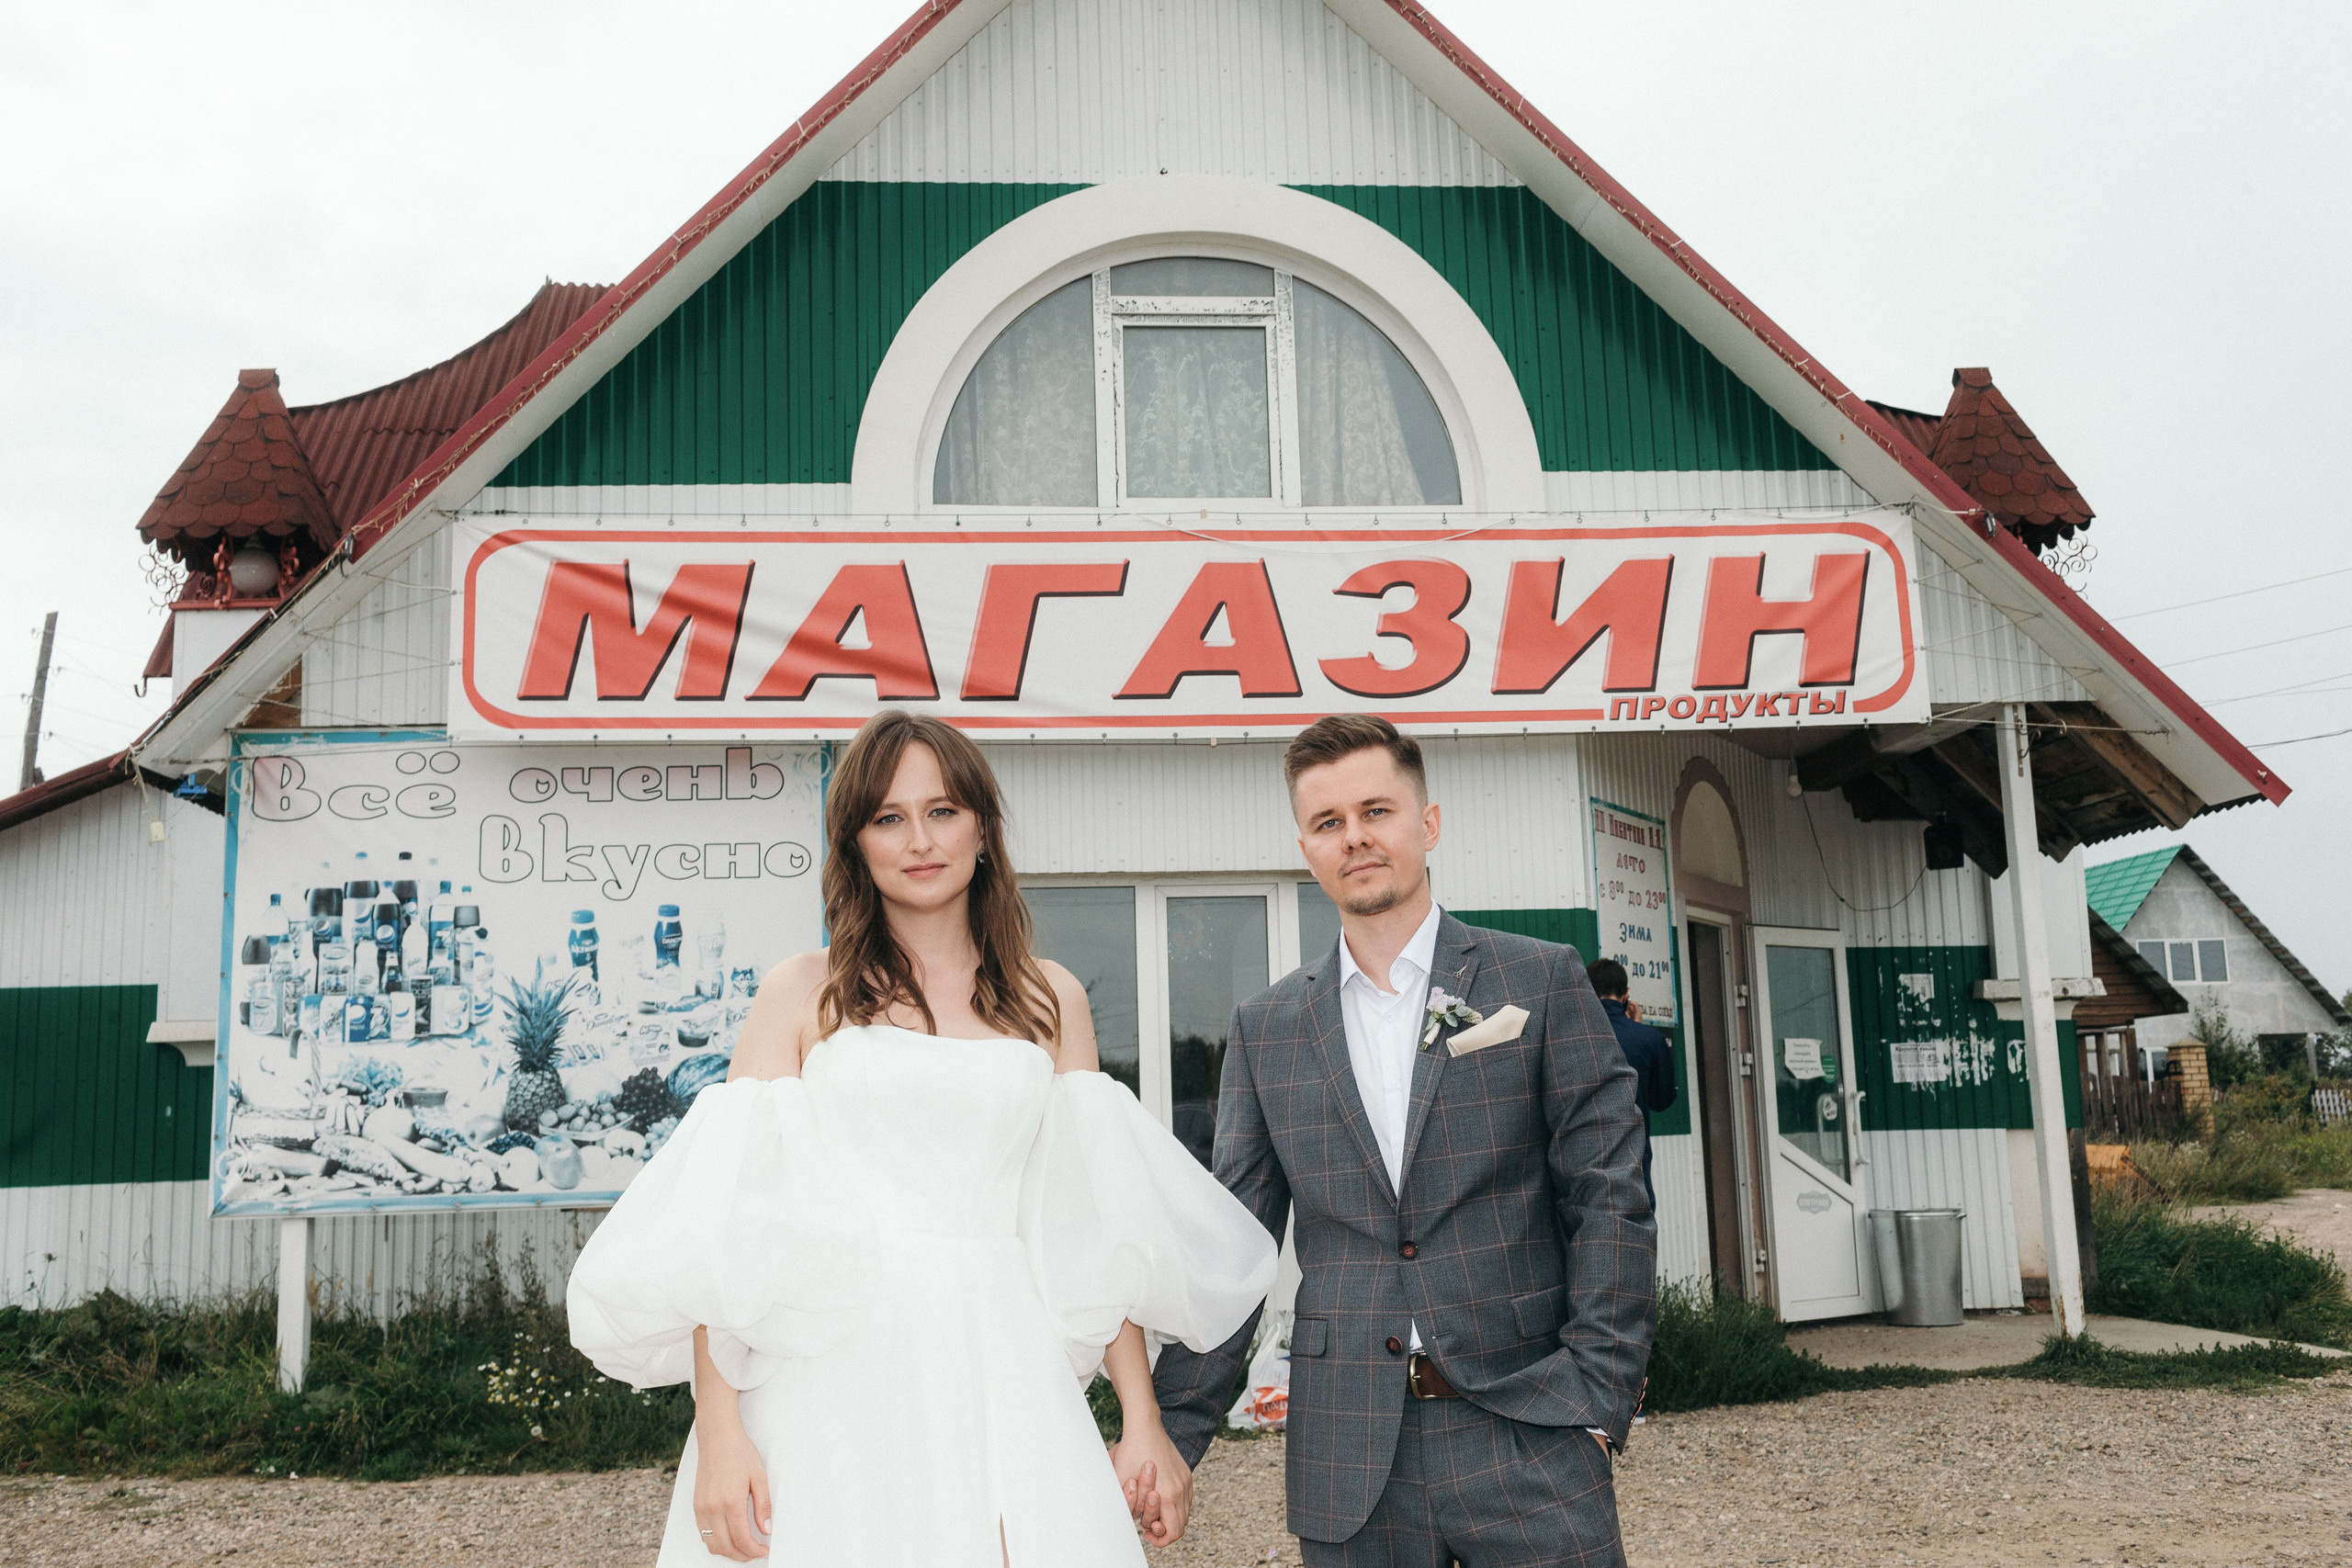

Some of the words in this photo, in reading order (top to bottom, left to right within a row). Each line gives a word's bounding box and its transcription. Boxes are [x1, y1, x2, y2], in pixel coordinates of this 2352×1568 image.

[515, 549, 1871, 702] МАГАЗИН
[1610, 690, 1847, 723] ПРОДУКТЫ
[252, 751, 459, 822] Всё
[509, 747, 785, 804] очень
[1632, 962, 1645, 979] до
